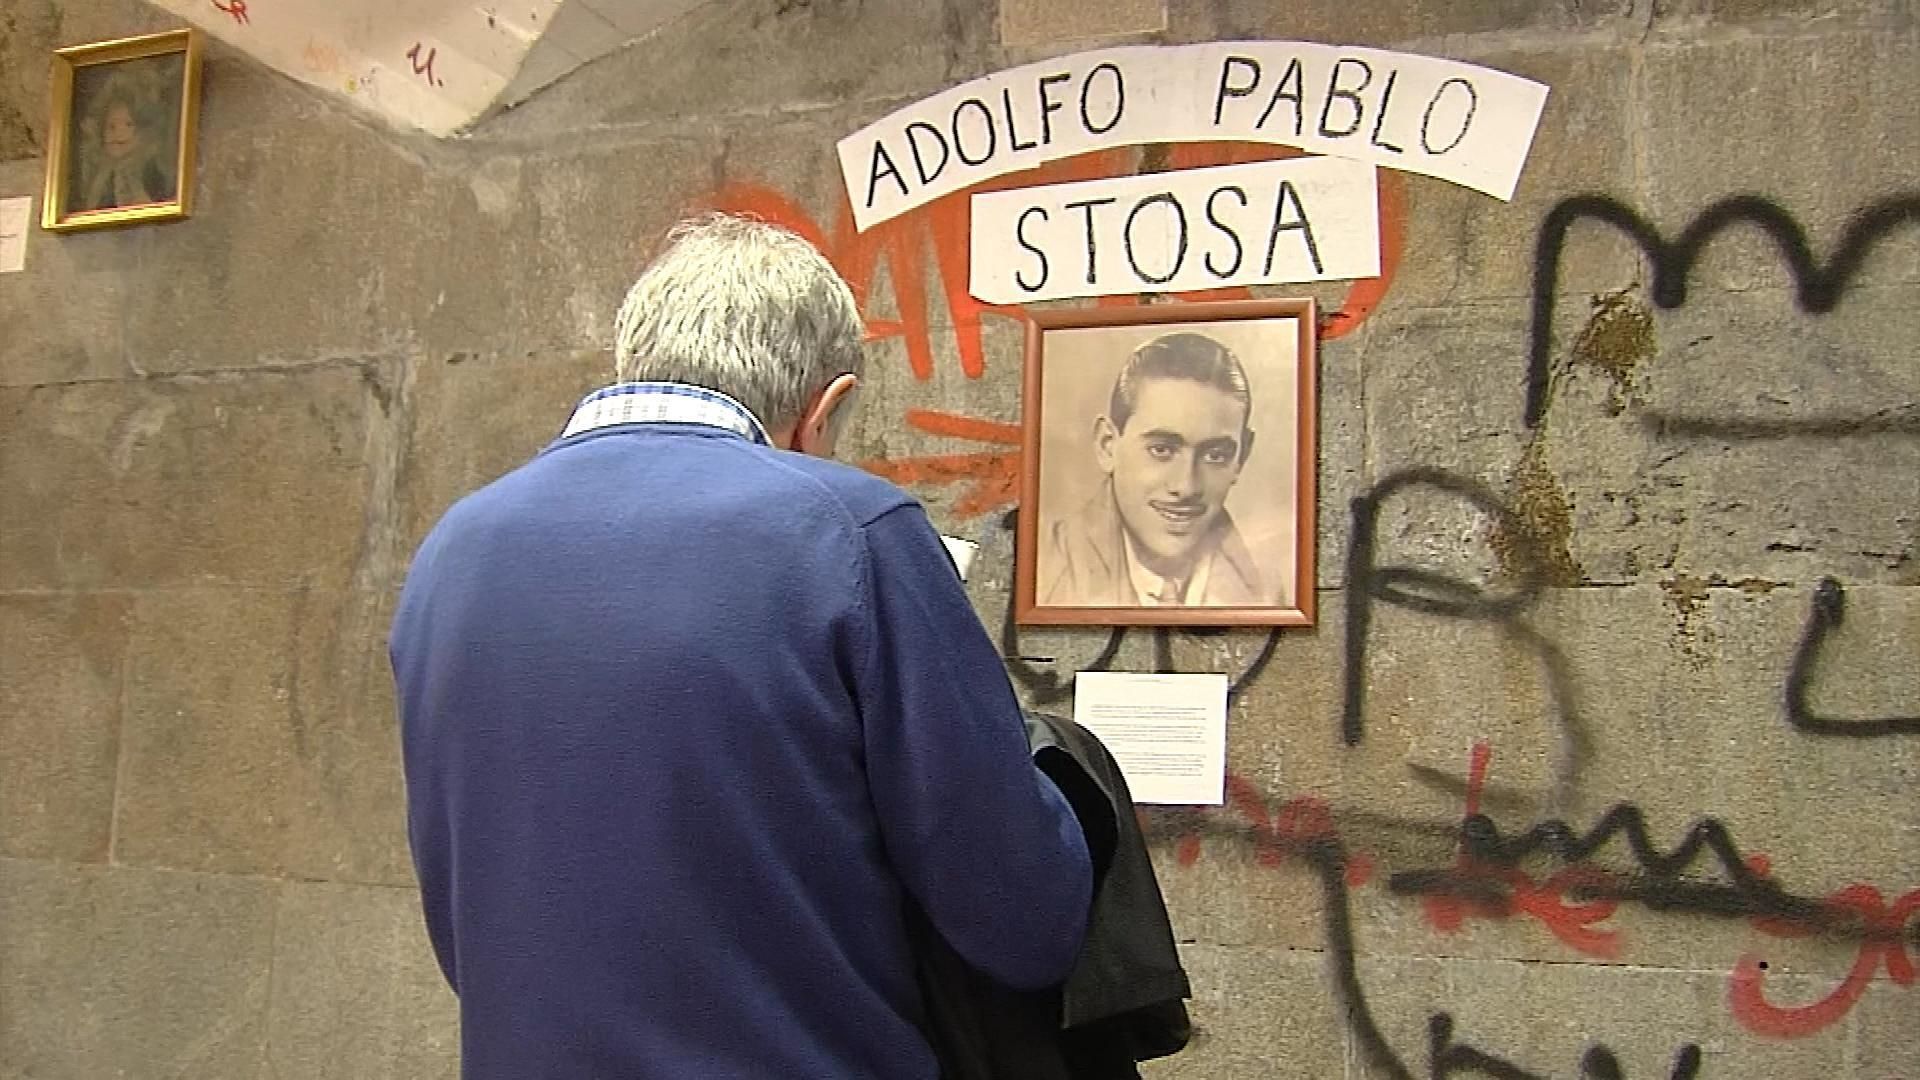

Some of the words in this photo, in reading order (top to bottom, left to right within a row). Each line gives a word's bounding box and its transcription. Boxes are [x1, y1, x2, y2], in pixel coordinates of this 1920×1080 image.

[865, 62, 1126, 208] ADOLFO
[1213, 56, 1479, 155] PABLO
[1015, 180, 1325, 294] STOSA
